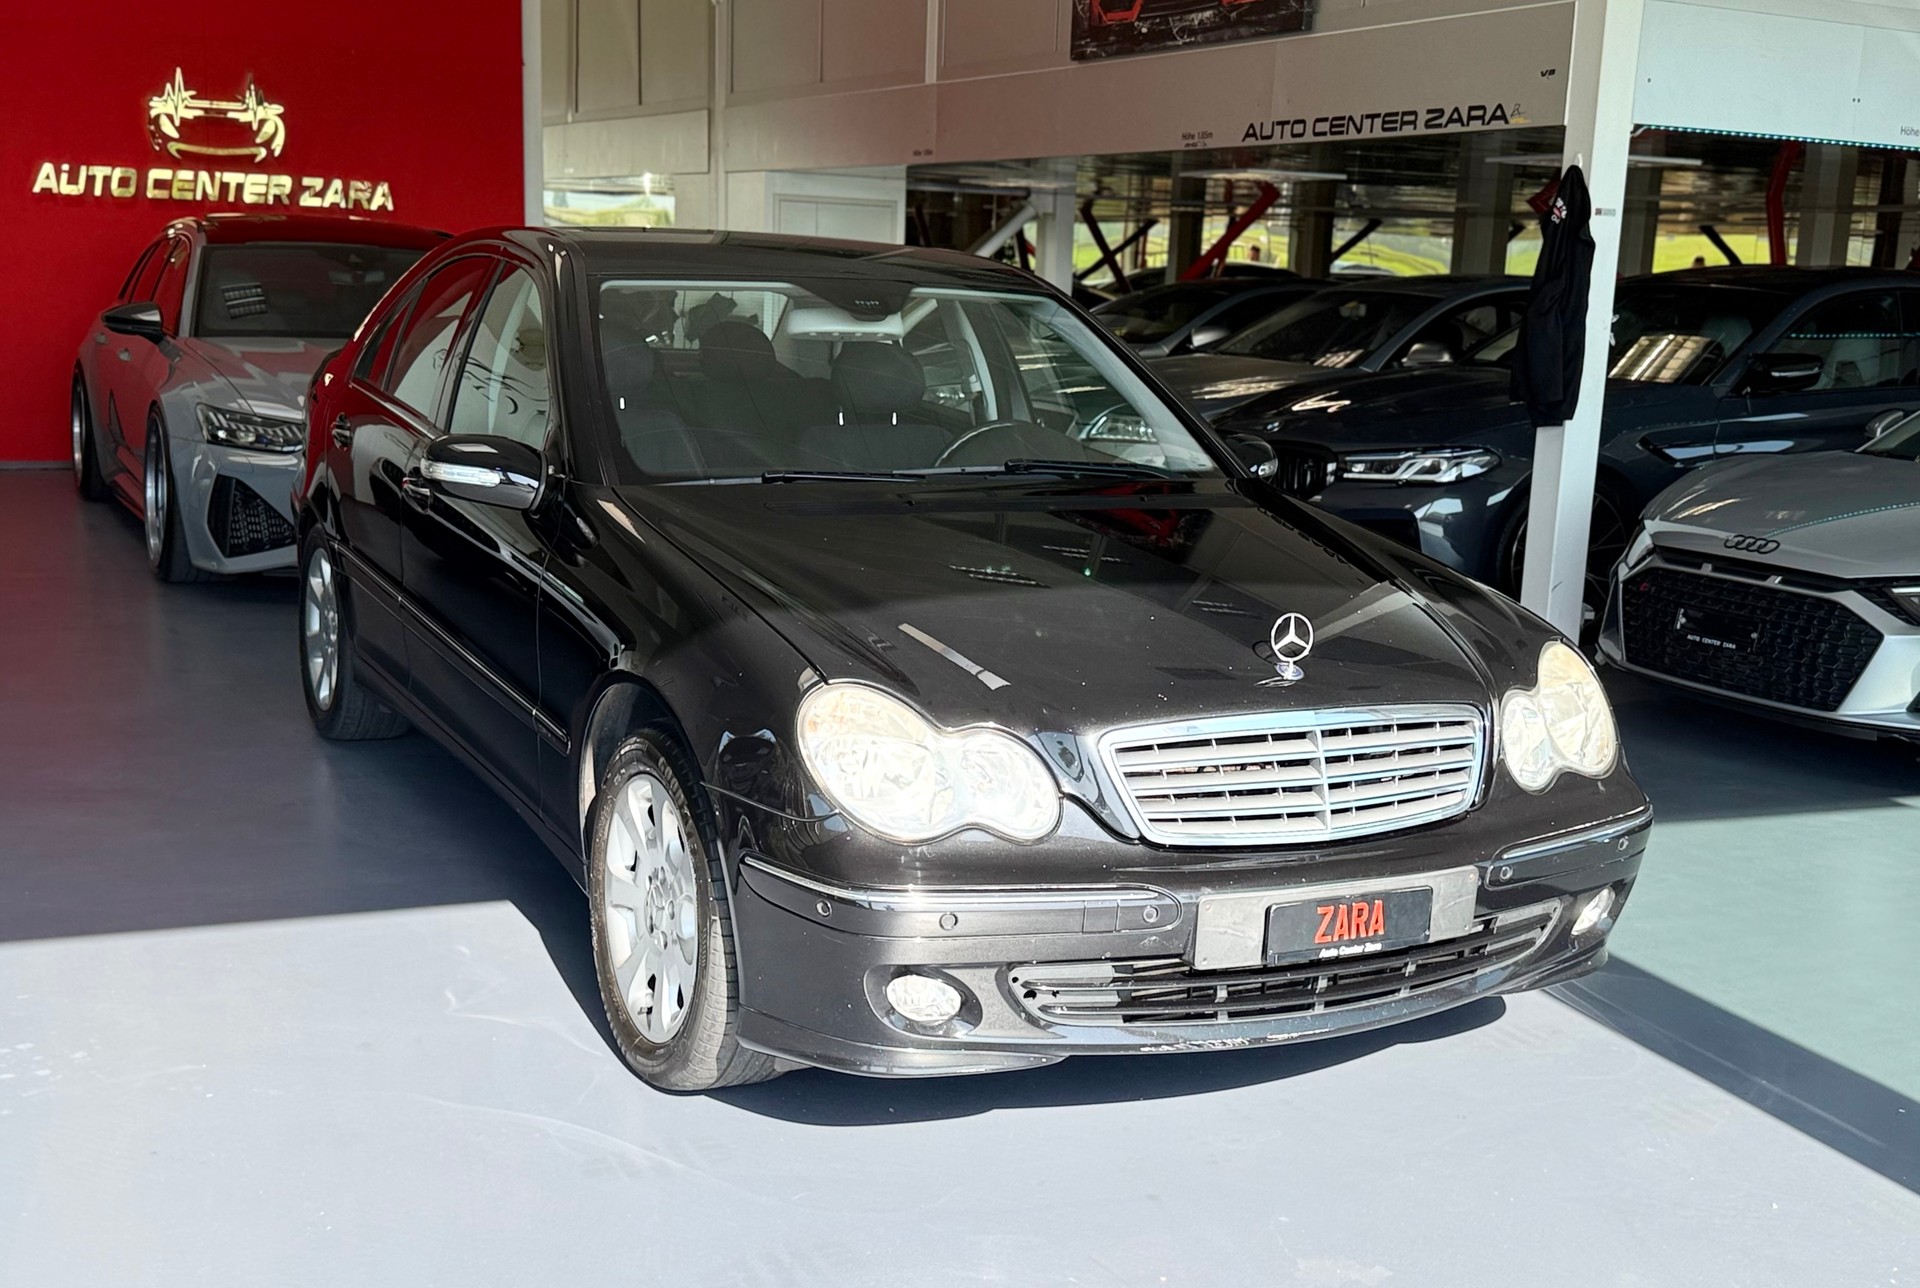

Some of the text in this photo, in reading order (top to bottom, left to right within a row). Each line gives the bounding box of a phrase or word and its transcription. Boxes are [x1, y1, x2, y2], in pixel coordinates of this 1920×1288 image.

[1241, 103, 1510, 143] AUTO CENTER ZARA
[32, 161, 395, 212] AUTO CENTER ZARA
[1315, 901, 1384, 944] ZARA
[1319, 942, 1382, 958] Auto Center Zara
